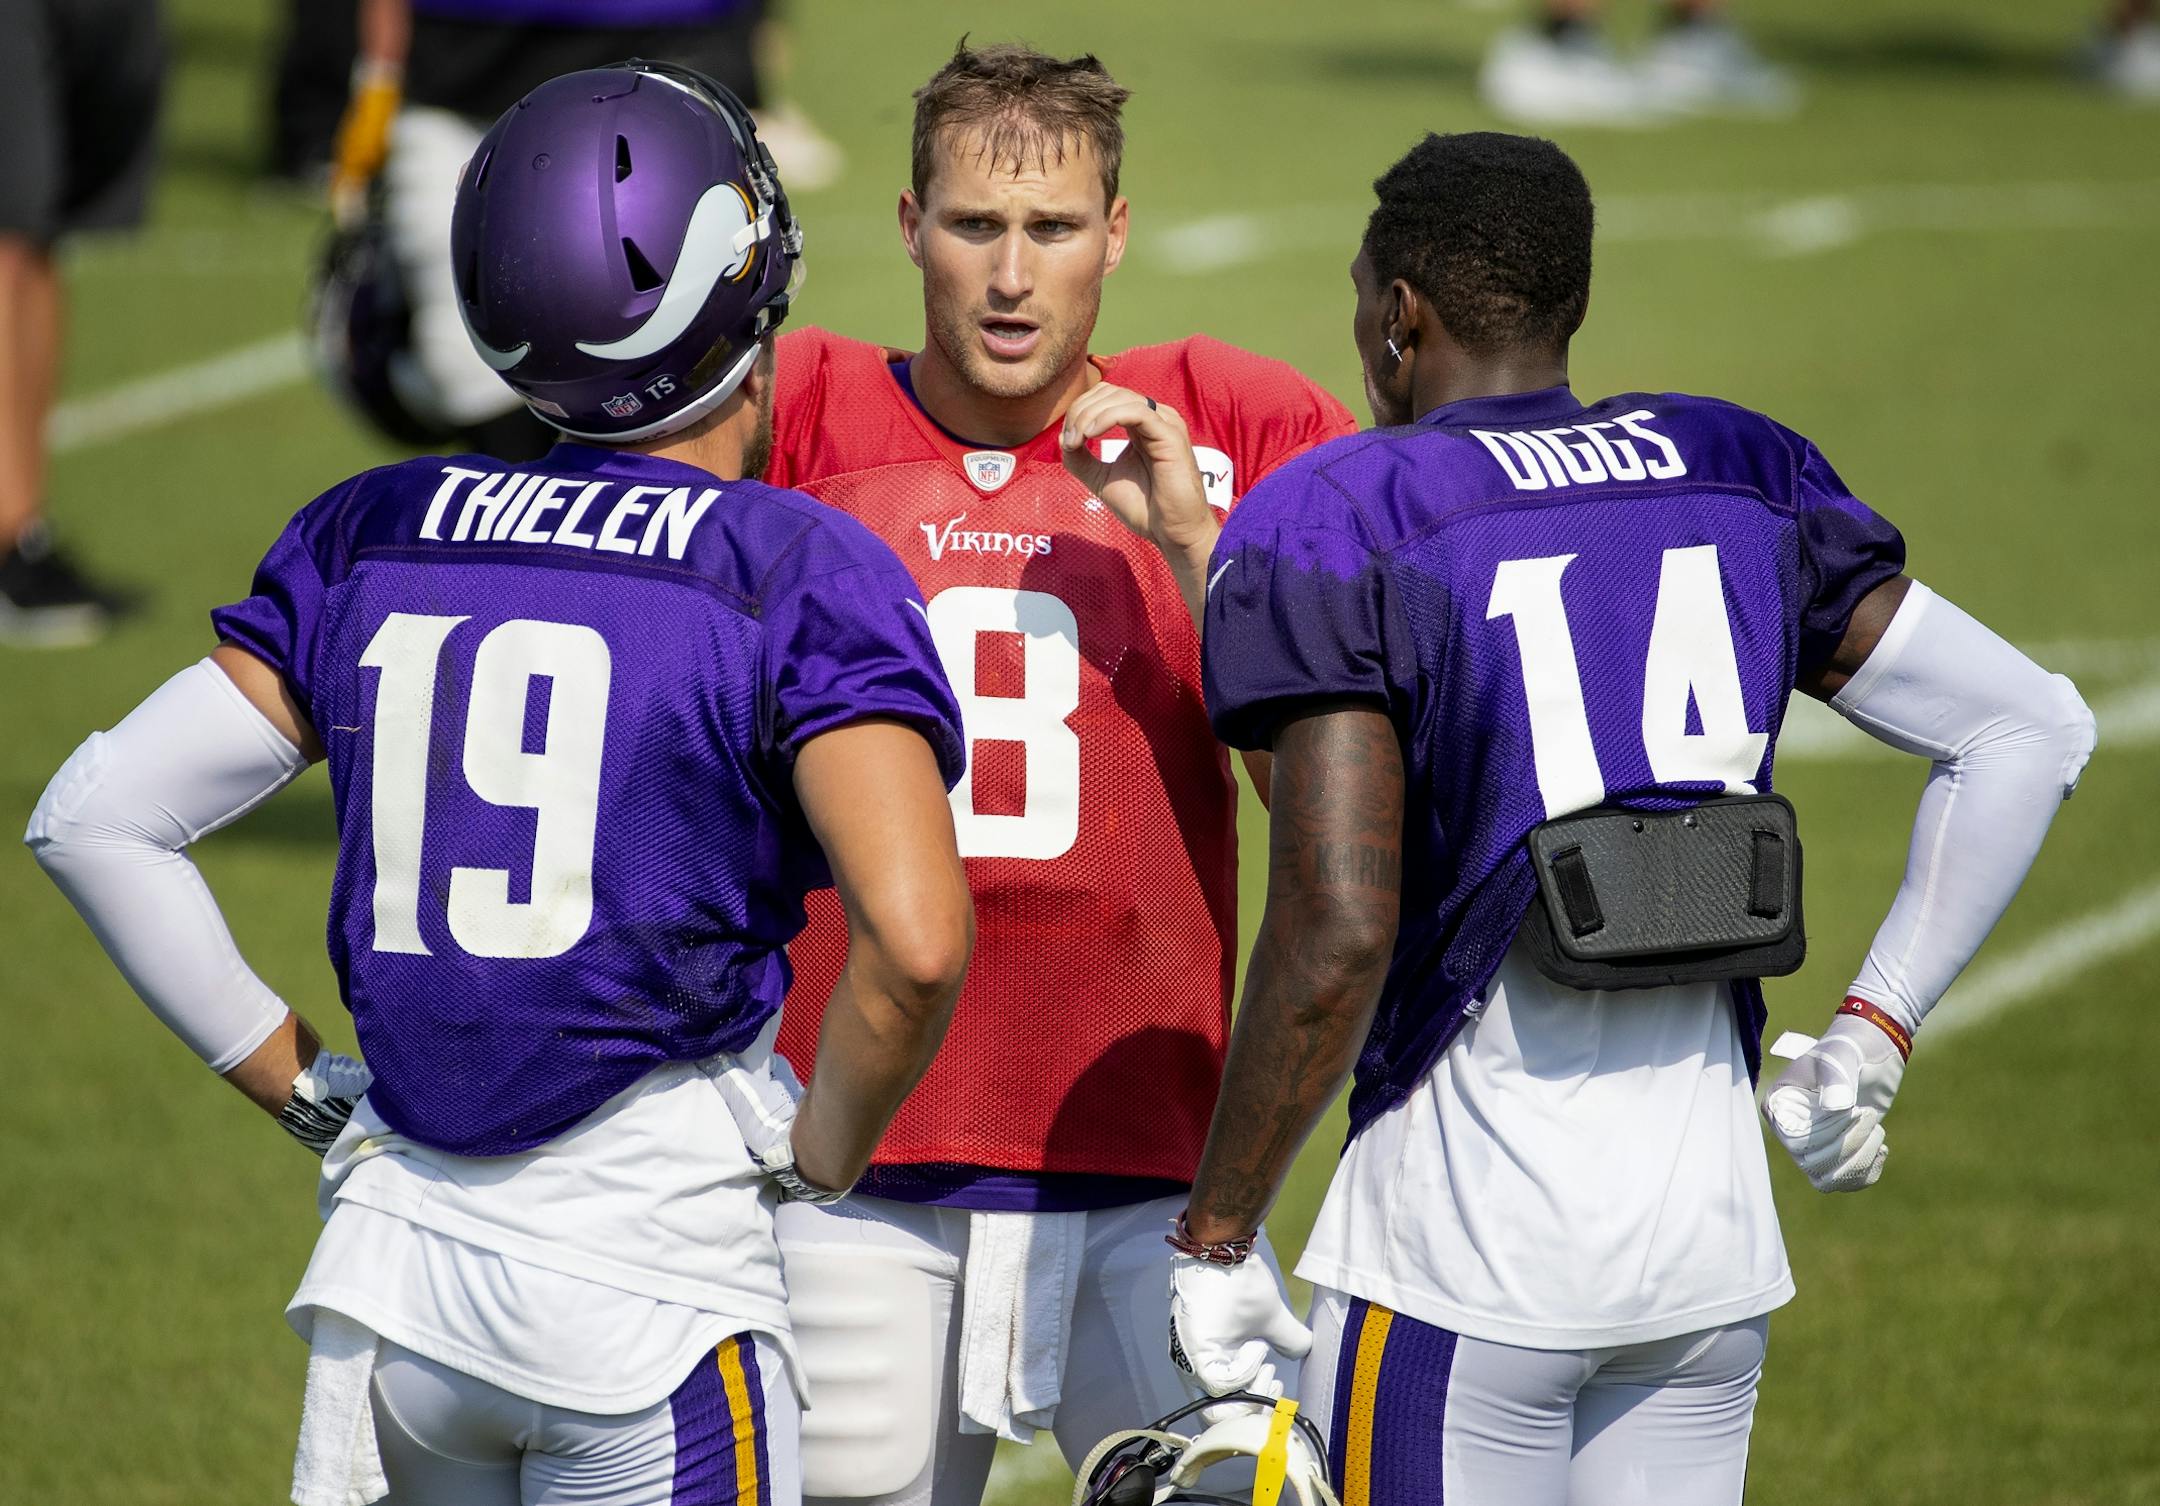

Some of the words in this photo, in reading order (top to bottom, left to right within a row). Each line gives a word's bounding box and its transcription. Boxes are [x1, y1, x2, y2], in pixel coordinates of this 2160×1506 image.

[645, 377, 676, 400] TS
[980, 470, 999, 481] NFL
[1469, 410, 1687, 490] DIGGS
[419, 466, 723, 560] THIELEN
[926, 586, 1080, 860] 8
[1486, 544, 1769, 821] 14
[358, 612, 612, 958] 19
[1871, 1012, 1899, 1038] Dedication
